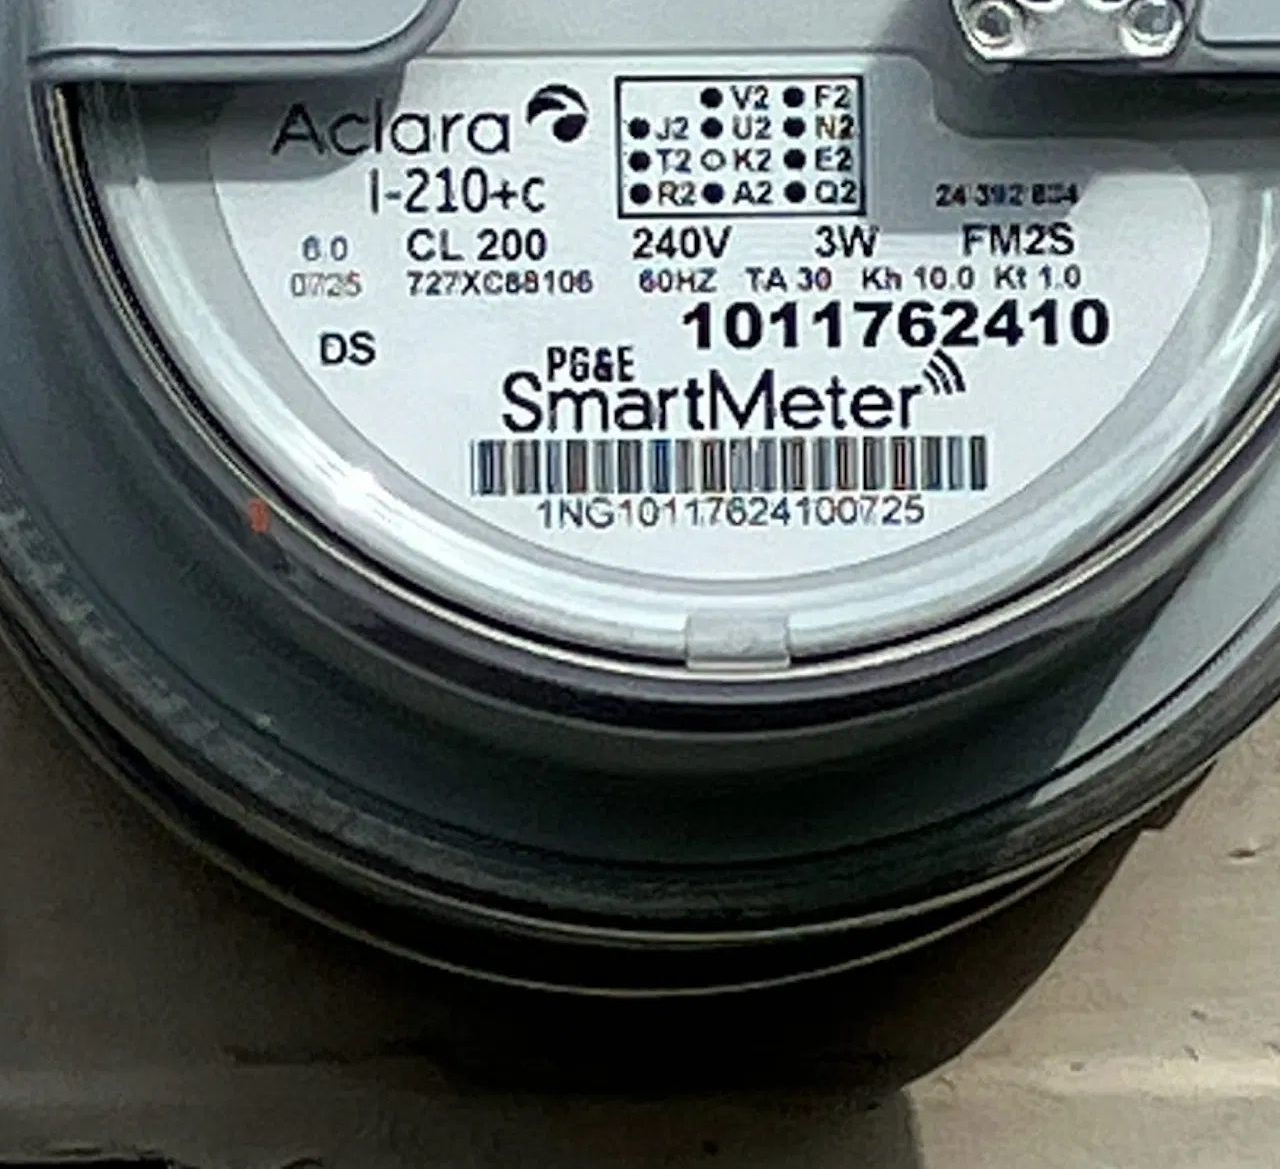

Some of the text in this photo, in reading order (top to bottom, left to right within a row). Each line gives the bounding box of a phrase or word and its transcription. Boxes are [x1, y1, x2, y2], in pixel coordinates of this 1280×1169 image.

[730, 85, 852, 111] V2 F2
[271, 97, 512, 157] Aclara
[655, 114, 855, 141] J2 U2 N2
[655, 146, 852, 174] T2 K2 E2
[658, 180, 858, 207] R2 A2 Q2
[935, 183, 966, 207] 24
[406, 228, 547, 262] CL 200
[632, 224, 1076, 260] 240V 3W FM2S
[639, 264, 1081, 294] 60HZ TA 30 Kh 10.0 Kt 1.0
[682, 298, 1110, 350] 1011762410
[320, 330, 376, 366] DS
[547, 345, 635, 383] PG&E
[502, 369, 920, 434] SmartMeter
[538, 496, 925, 529] 1NG10117624100725
